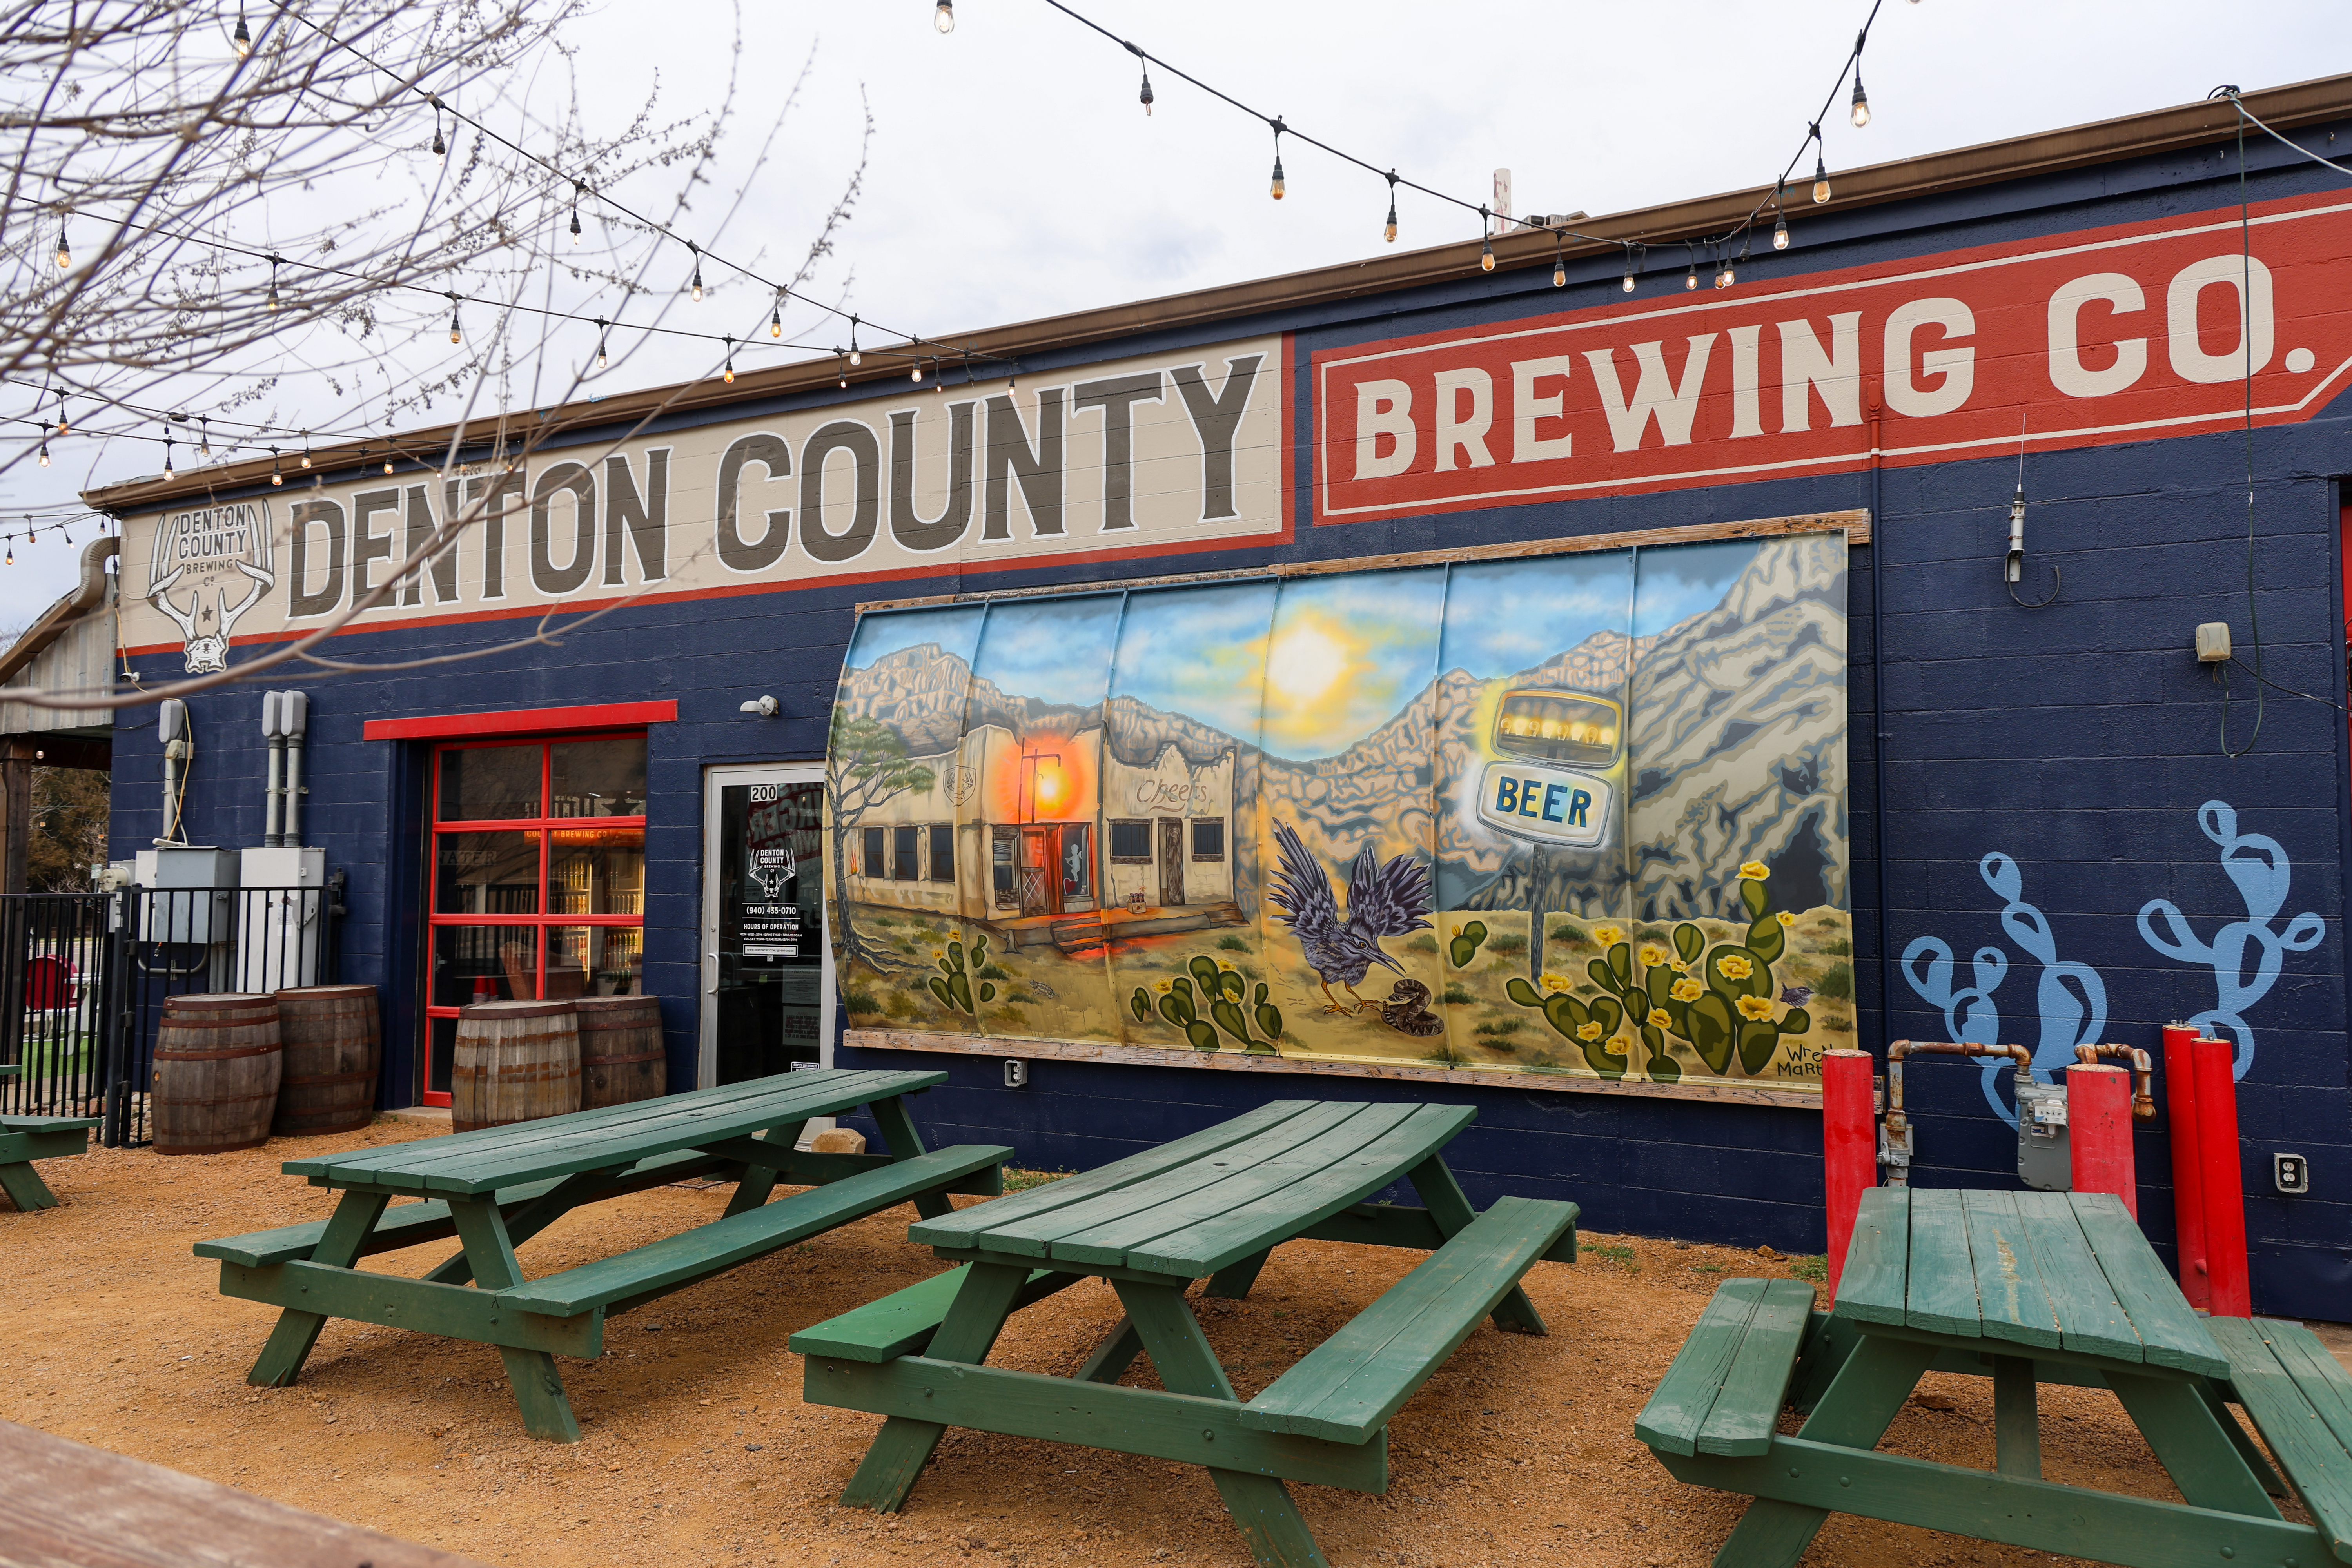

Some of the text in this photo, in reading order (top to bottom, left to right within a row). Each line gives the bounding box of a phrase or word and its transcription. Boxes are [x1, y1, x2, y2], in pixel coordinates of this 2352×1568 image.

[1351, 254, 2315, 481] BREWING CO.
[285, 351, 1268, 621] DENTON COUNTY
[178, 503, 247, 537] DENTON
[178, 528, 248, 561] COUNTY
[186, 559, 232, 574] BREWING
[752, 786, 776, 801] 200
[1496, 776, 1592, 828] BEER
[746, 906, 765, 915] (940)
[1777, 1062, 1822, 1077] MaRt
